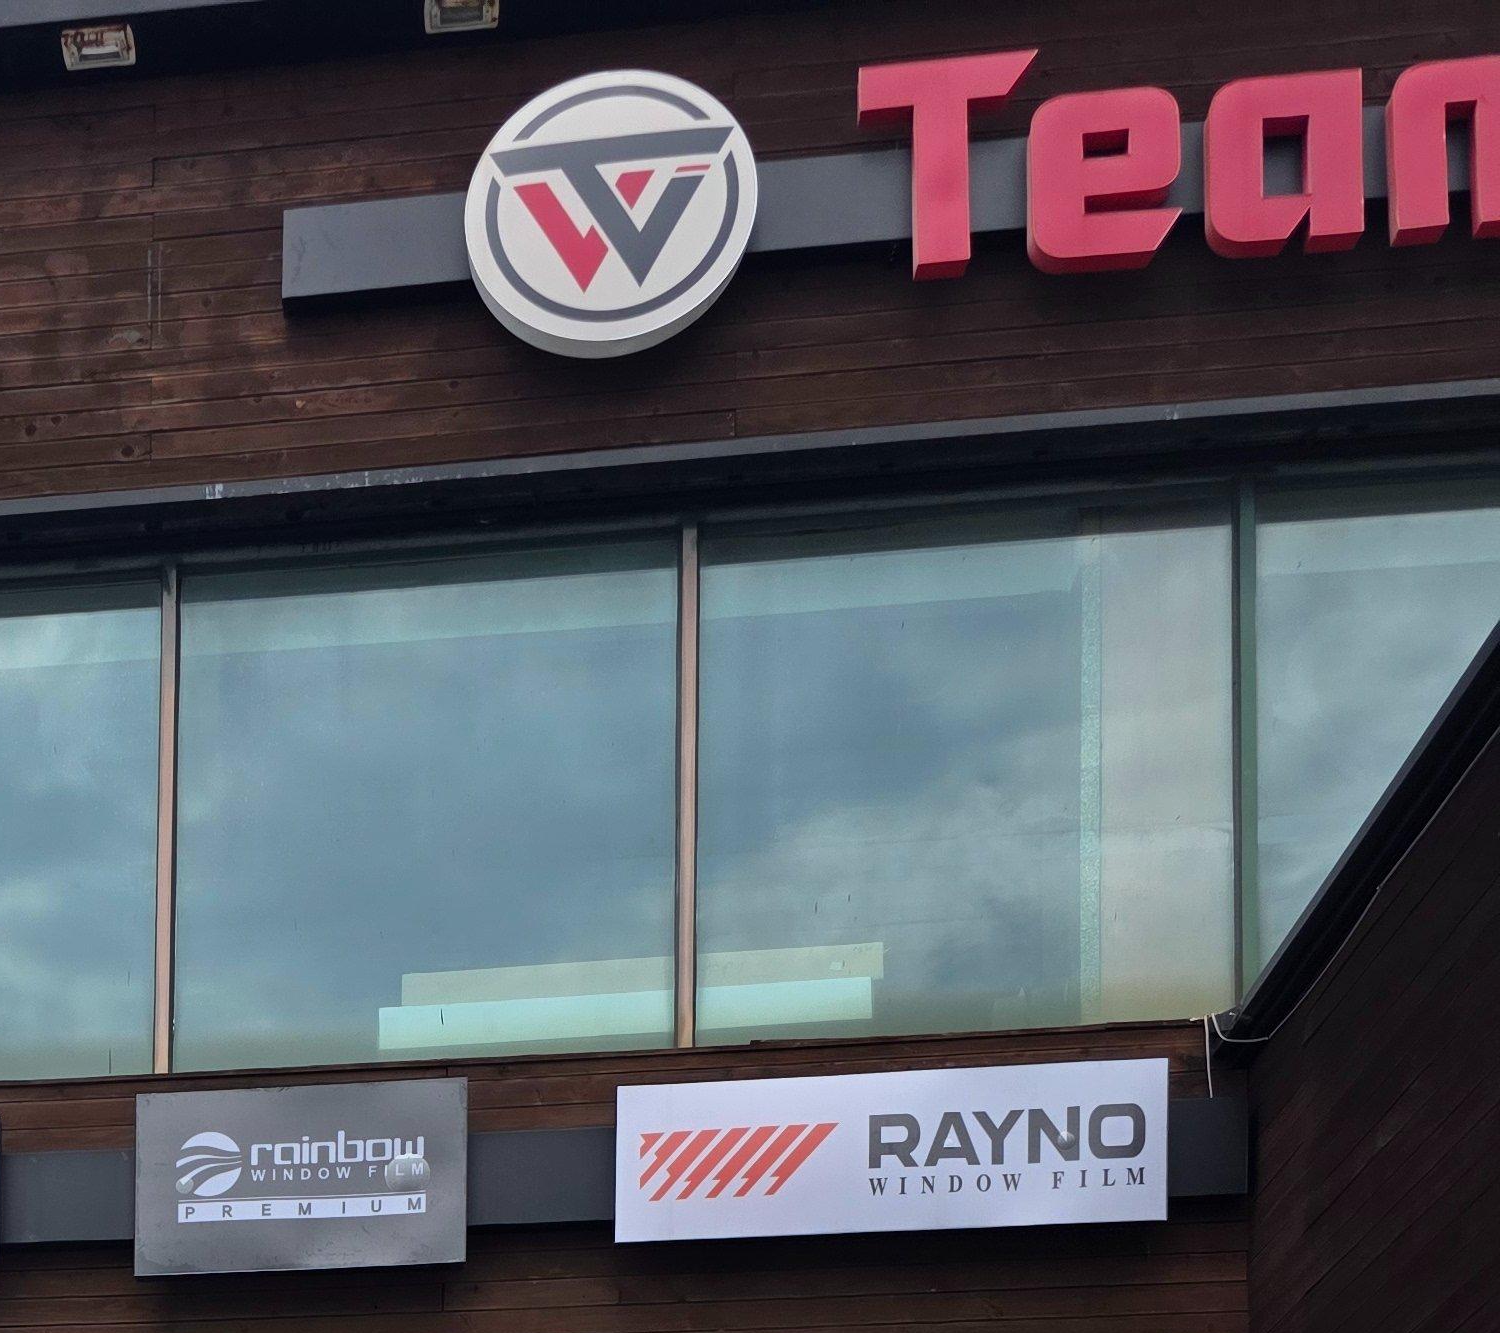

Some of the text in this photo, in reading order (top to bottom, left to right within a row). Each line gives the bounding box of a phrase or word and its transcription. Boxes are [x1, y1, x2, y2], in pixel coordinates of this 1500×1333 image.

[250, 1130, 425, 1166] rainbow
[868, 1103, 1147, 1169] RAYNO
[250, 1162, 425, 1182] WINDOW FILM
[868, 1167, 1147, 1197] WINDOW FILM
[185, 1197, 423, 1219] PREMIUM
